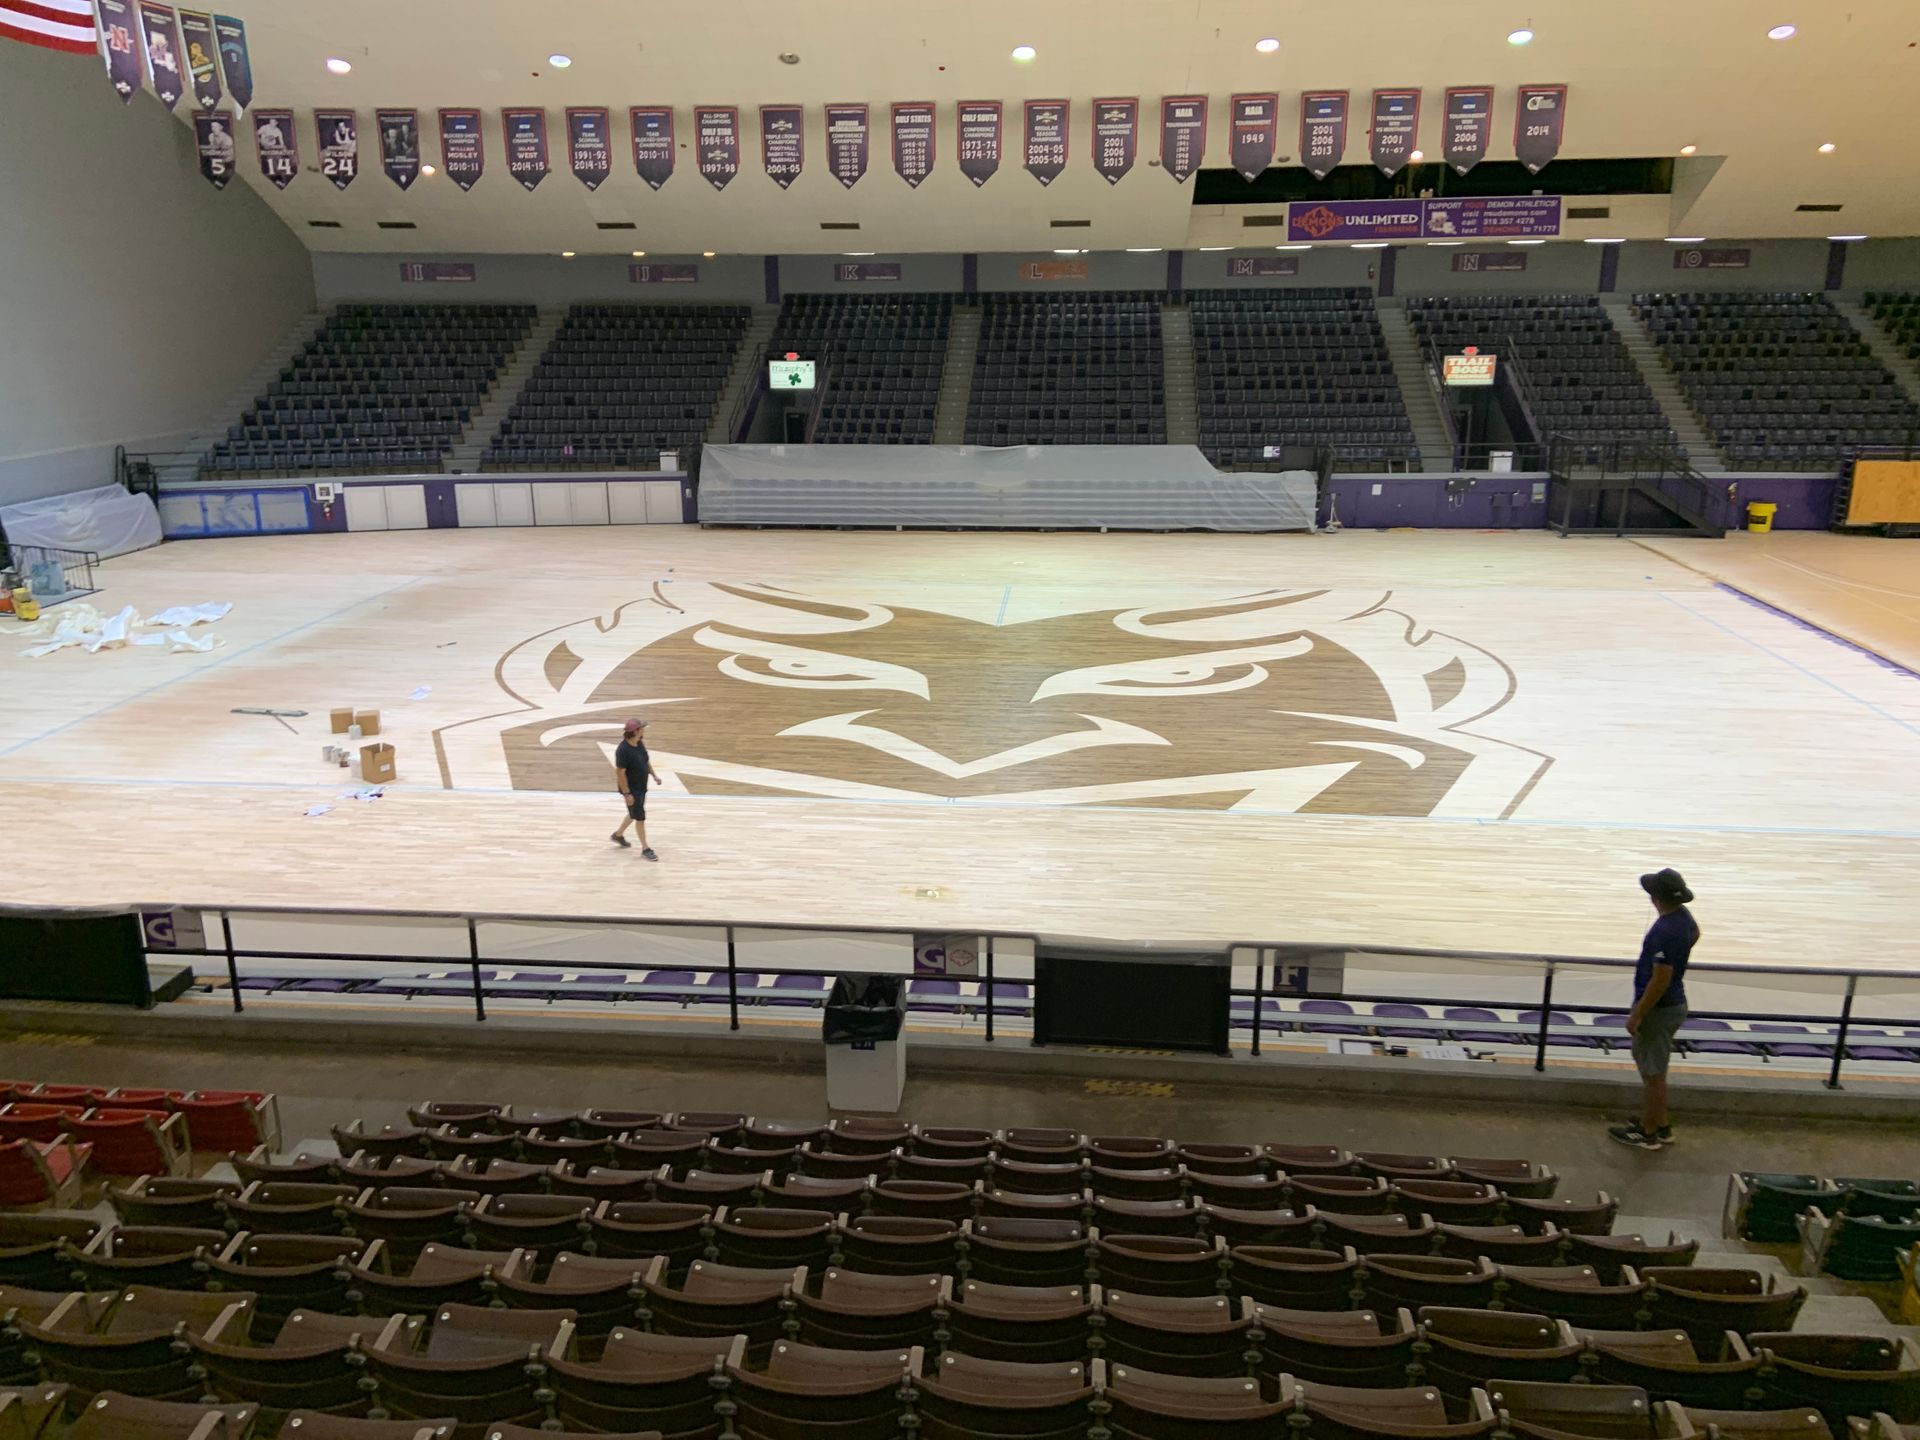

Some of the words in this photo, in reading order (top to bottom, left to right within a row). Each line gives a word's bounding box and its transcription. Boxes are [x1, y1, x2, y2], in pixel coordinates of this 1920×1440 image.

[1312, 126, 1333, 135] 2001
[1526, 126, 1550, 136] 2014
[700, 136, 735, 146] 1984-85
[1104, 138, 1124, 147] 2001
[1242, 133, 1265, 144] 1949
[1311, 136, 1334, 146] 2006
[1381, 135, 1403, 145] 2001
[1454, 133, 1478, 143] 2006
[962, 140, 997, 149] 1973-74
[1028, 145, 1064, 154] 2004-05
[1103, 148, 1125, 157] 2006
[1311, 146, 1332, 156] 2013
[574, 151, 607, 159] 1991-92
[639, 151, 669, 159] 2010-11
[961, 150, 997, 159] 1974-75
[1028, 155, 1064, 164] 2005-06
[1103, 157, 1124, 167] 2013
[211, 158, 226, 175] 5
[266, 158, 292, 175] 14
[324, 158, 354, 176] 24
[449, 162, 479, 171] 2010-11
[512, 162, 545, 171] 2014-15
[574, 161, 608, 170] 2014-15
[702, 164, 736, 173] 1997-98
[767, 164, 800, 173] 2004-05
[1428, 202, 1462, 210] SUPPORT
[1487, 201, 1515, 209] DEMON
[1345, 214, 1419, 226] UNLIMITED
[1461, 218, 1477, 226] call
[1461, 226, 1478, 234] text
[1463, 254, 1479, 271] N
[1686, 250, 1702, 267] O
[1030, 263, 1044, 279] L
[1237, 259, 1254, 275] M
[843, 264, 859, 281] K
[1447, 357, 1493, 366] TRAIL
[1451, 366, 1489, 374] BOSS
[916, 944, 945, 970] G
[1279, 960, 1310, 986] F
